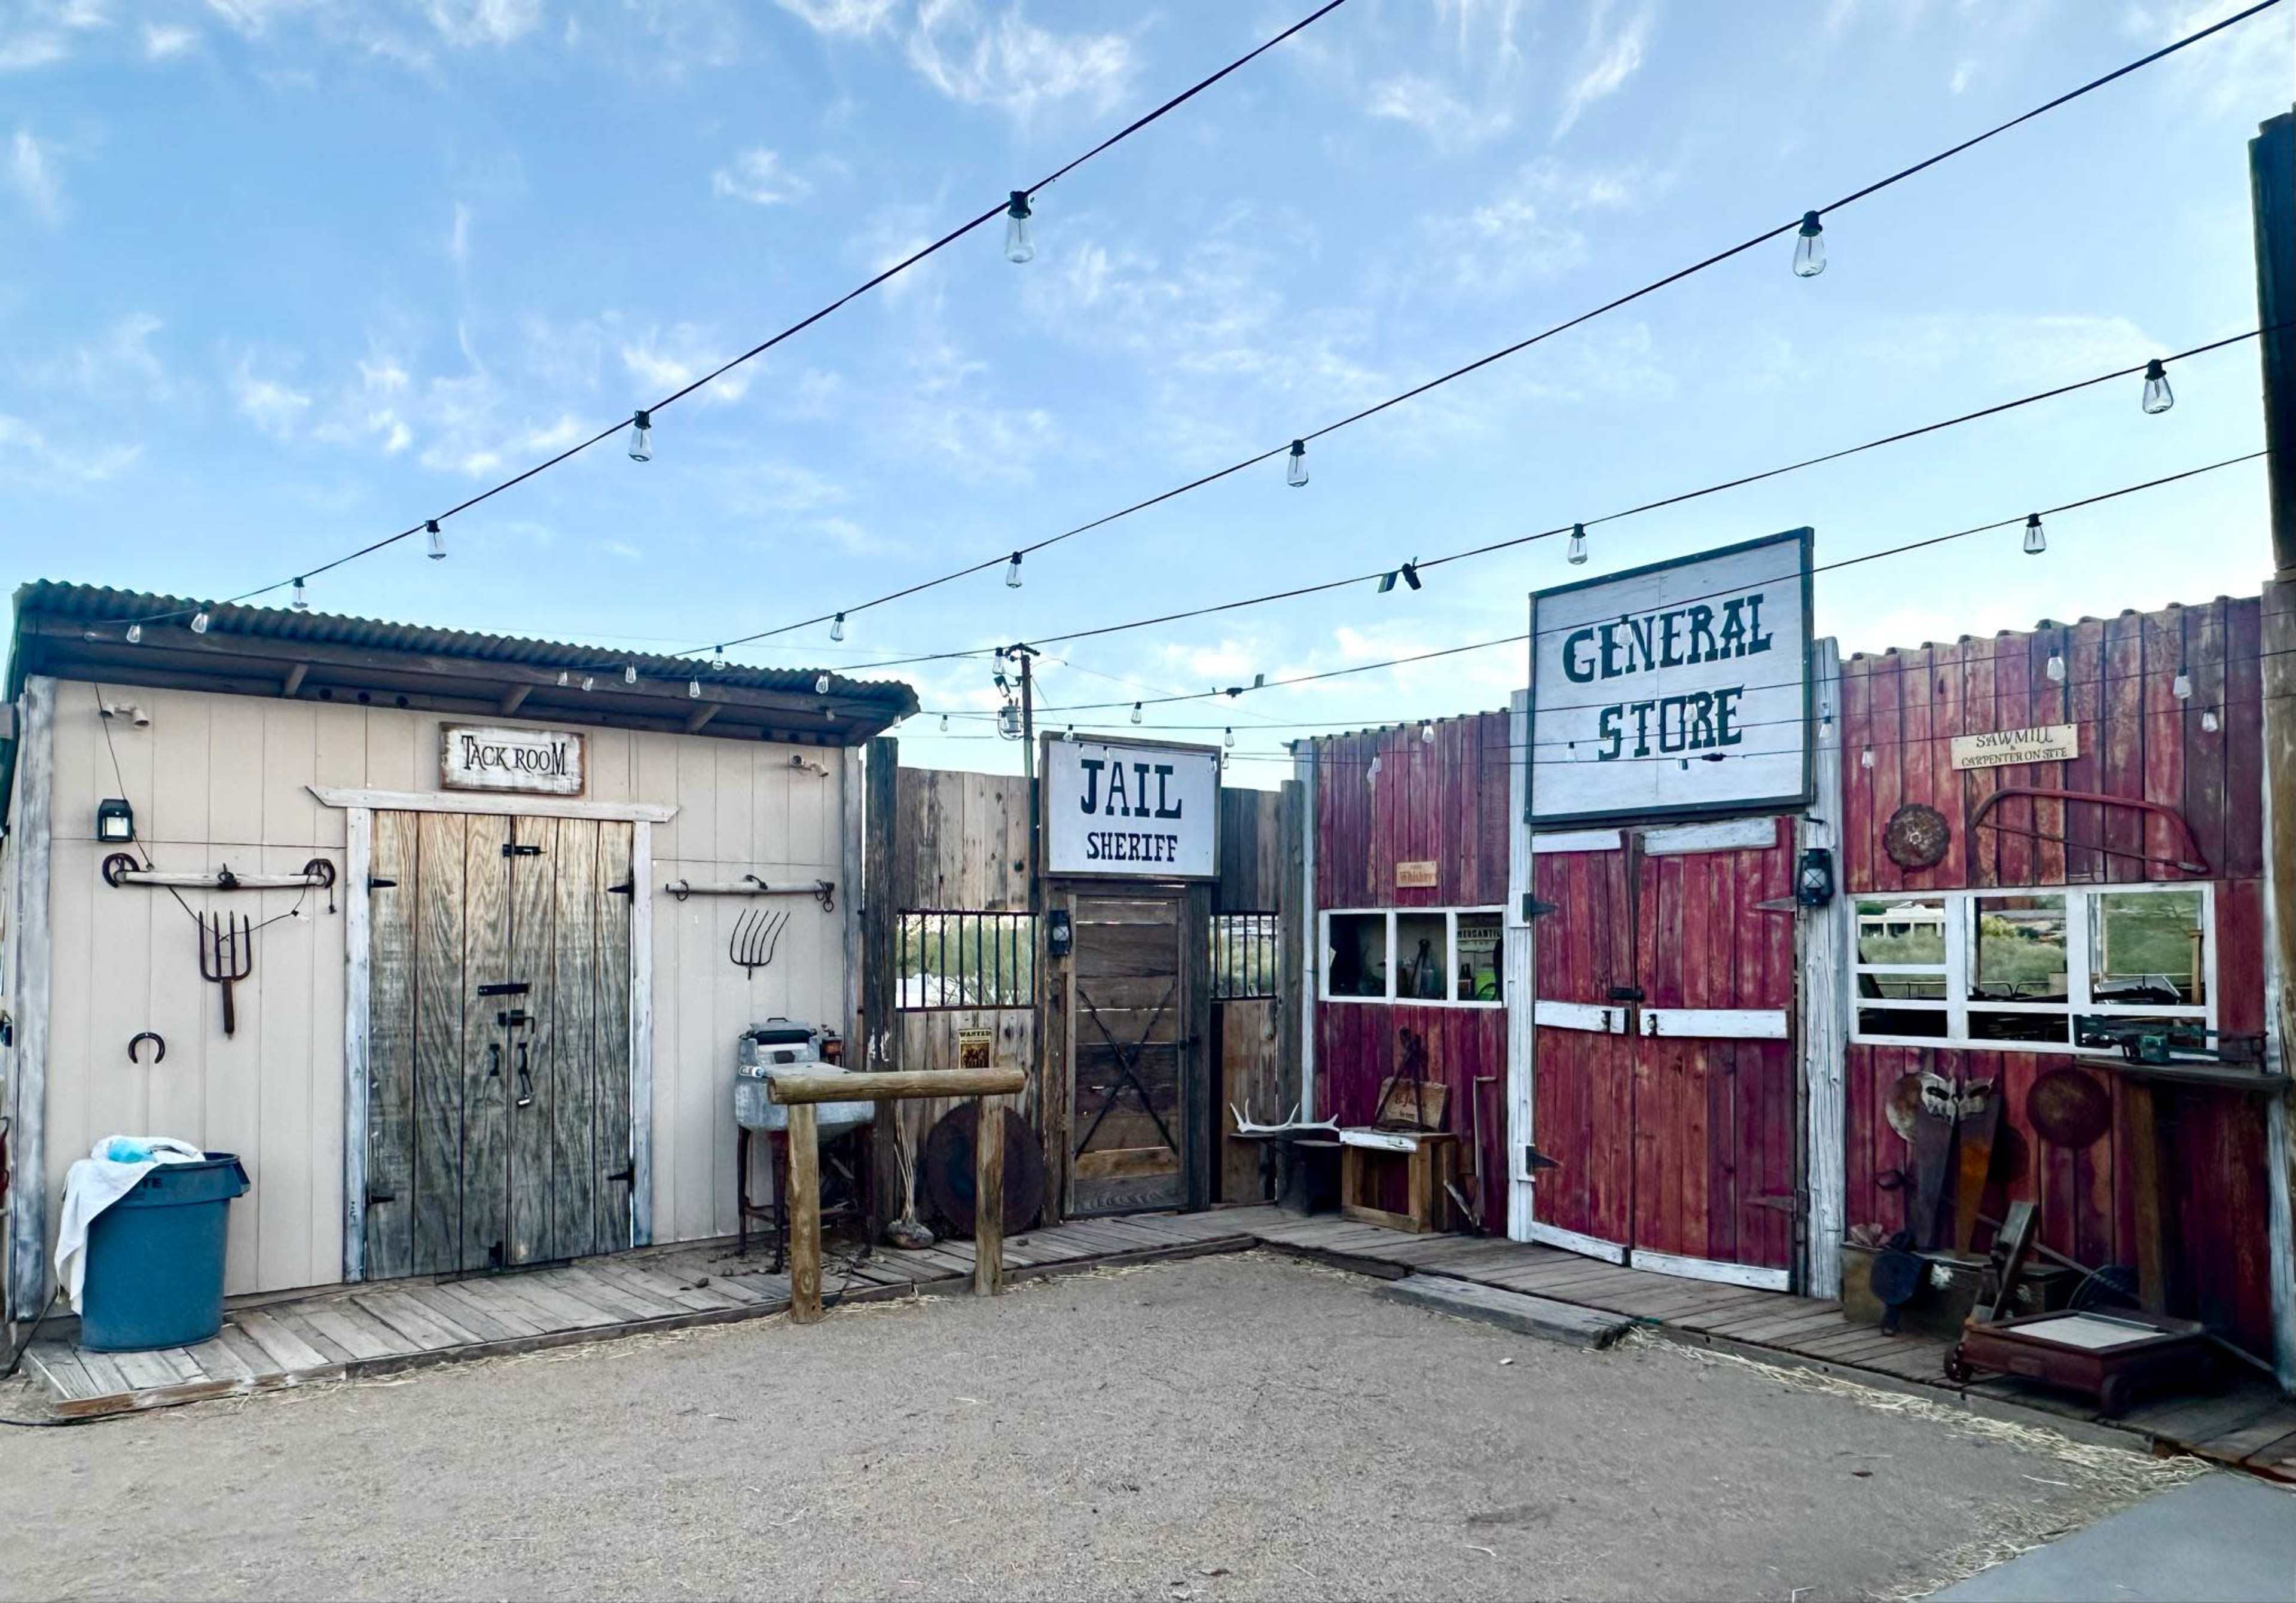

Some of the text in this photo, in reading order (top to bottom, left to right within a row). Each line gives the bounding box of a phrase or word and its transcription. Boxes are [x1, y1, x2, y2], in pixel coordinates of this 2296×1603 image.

[1562, 593, 1773, 683] GENERAL
[1598, 683, 1745, 761] STORE
[1976, 727, 2053, 748] SAWMILL
[461, 735, 566, 775] TACK ROOM
[1961, 747, 2068, 767] CARPENTER ON SITE
[1080, 759, 1182, 819] JAIL
[1086, 832, 1178, 862] SHERIFF
